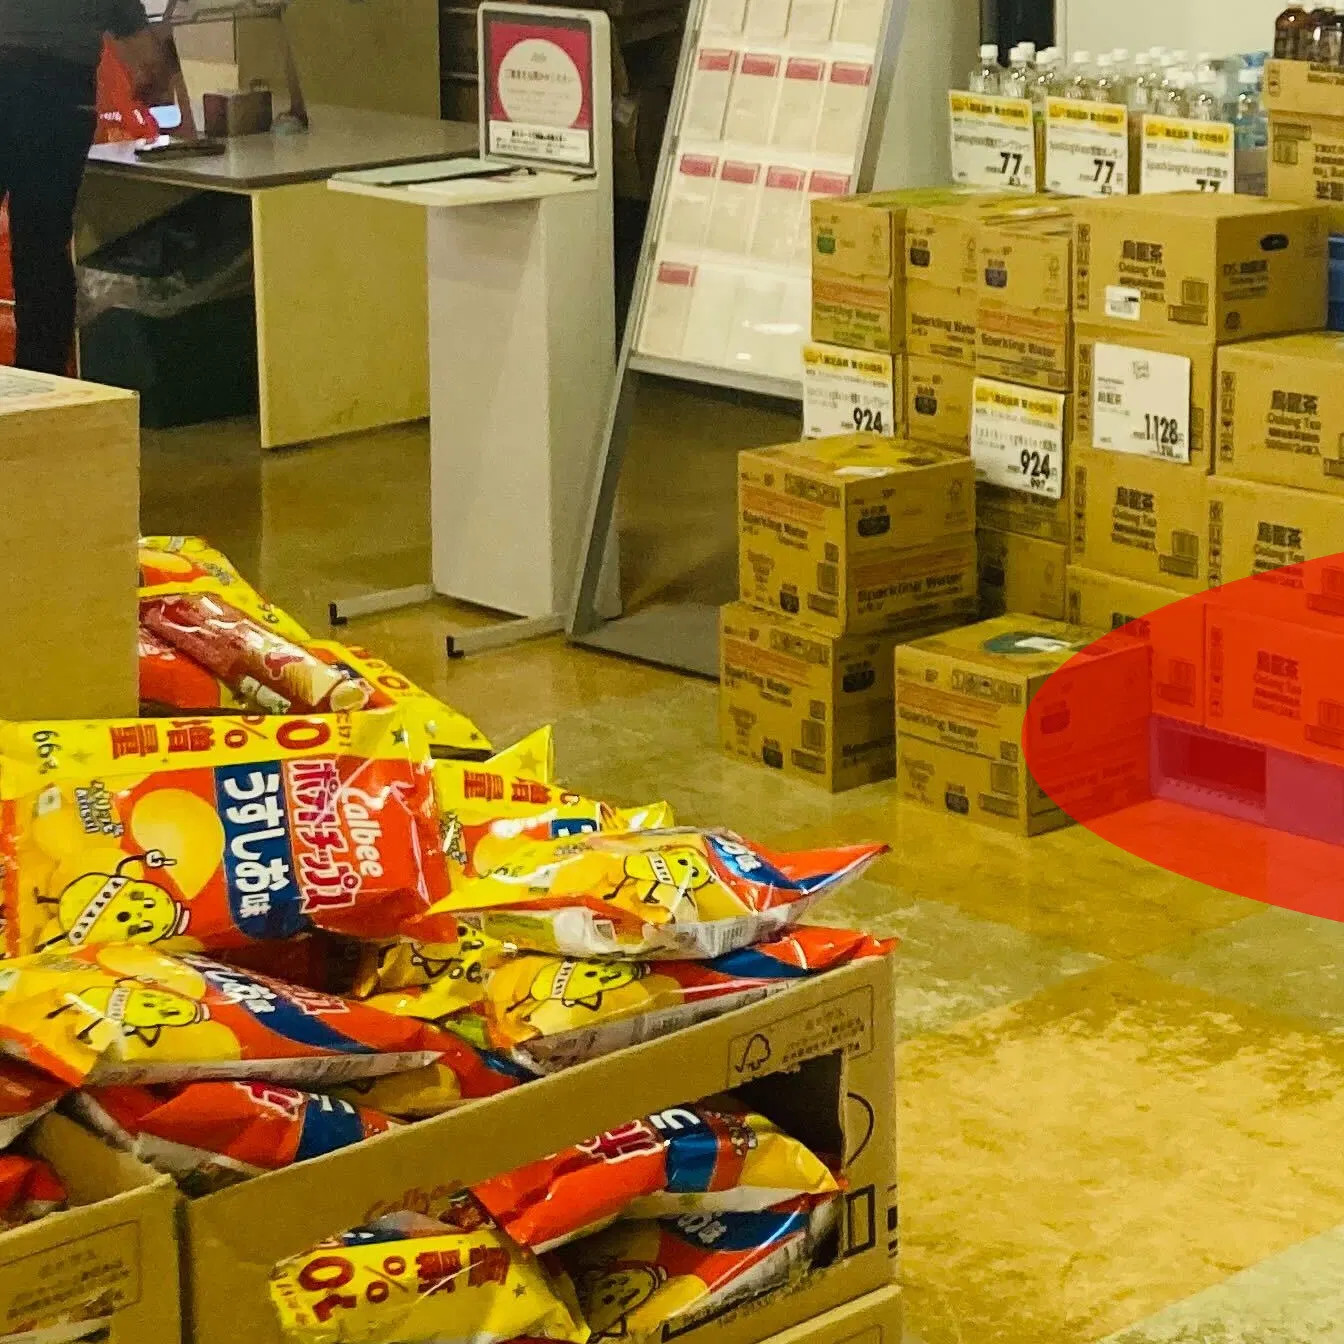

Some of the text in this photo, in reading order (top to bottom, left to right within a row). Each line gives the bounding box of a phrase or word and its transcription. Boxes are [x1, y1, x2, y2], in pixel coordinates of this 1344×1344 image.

[1000, 152, 1023, 176] 77
[1094, 159, 1115, 183] 77
[853, 407, 883, 433] 924
[1020, 450, 1050, 479] 924
[223, 770, 291, 920] うすしお味
[339, 783, 393, 879] Calbee
[67, 874, 130, 946] POTATO
